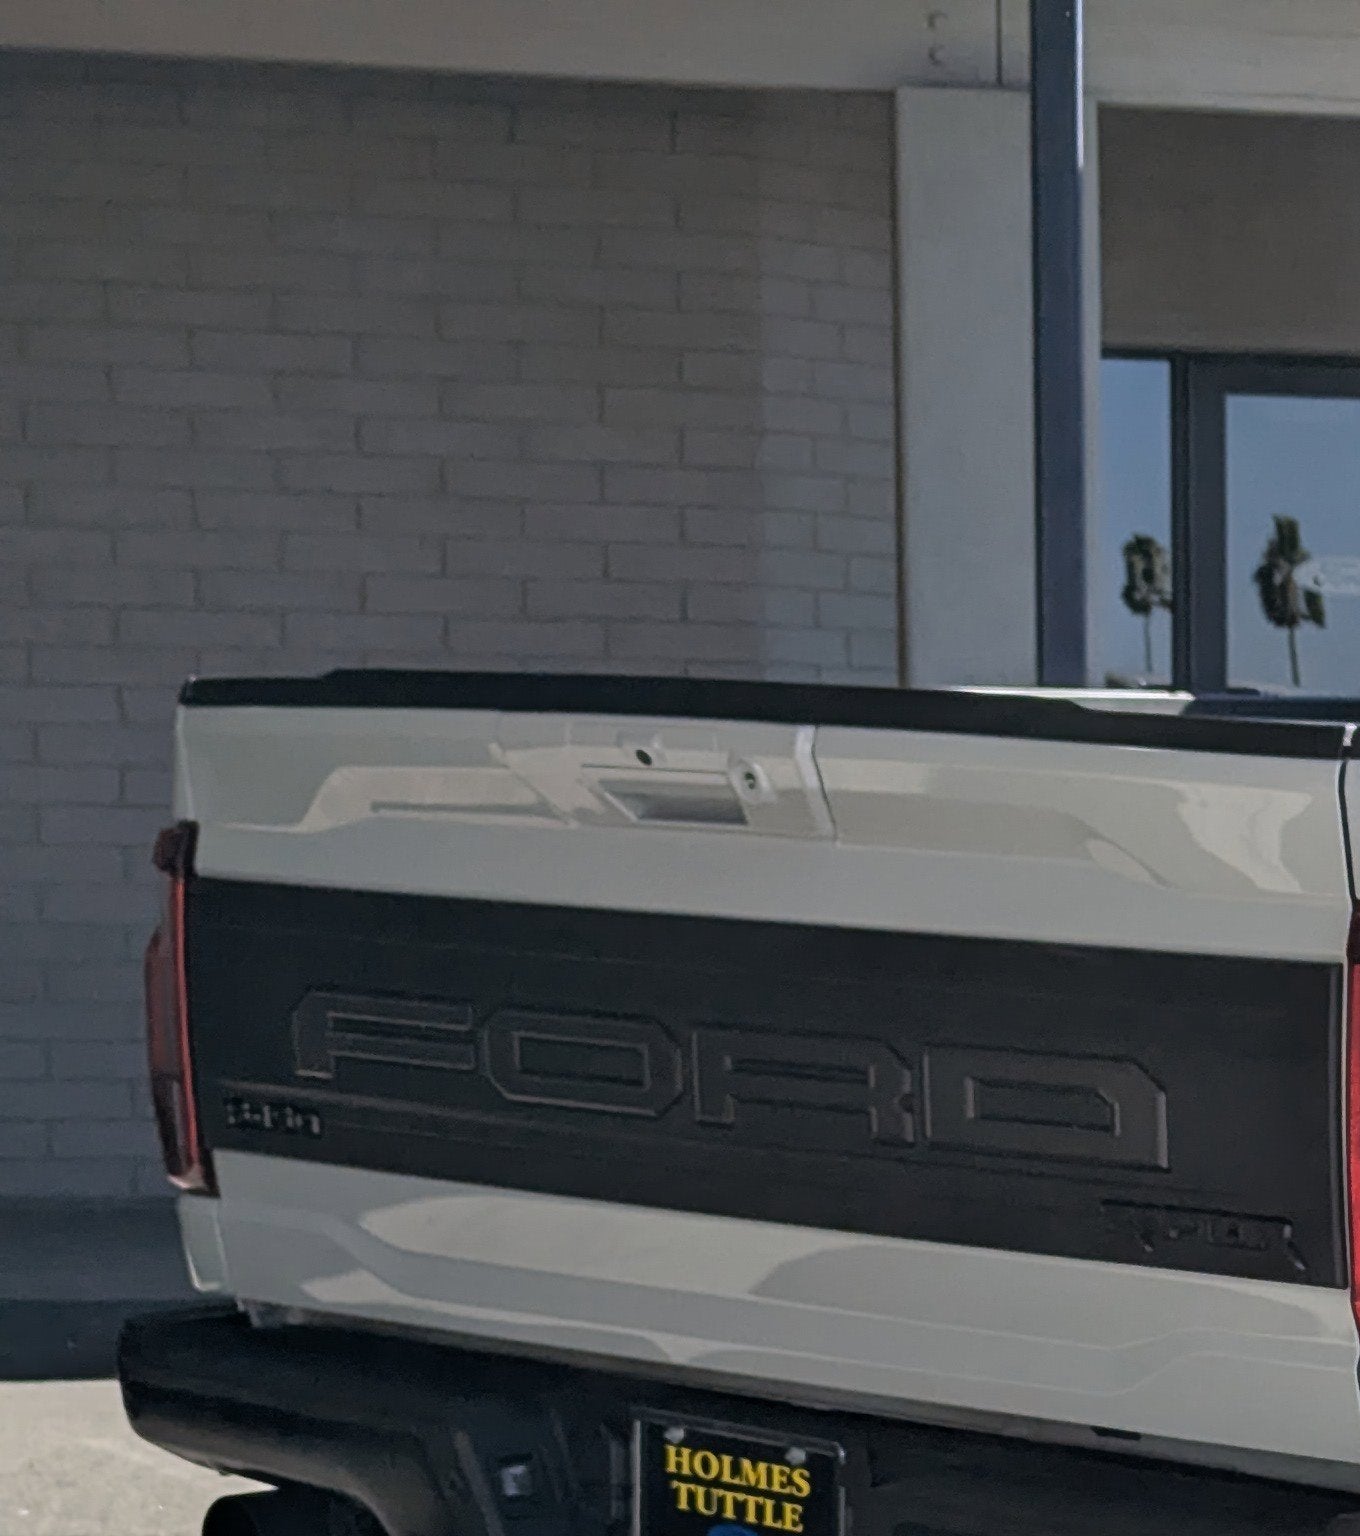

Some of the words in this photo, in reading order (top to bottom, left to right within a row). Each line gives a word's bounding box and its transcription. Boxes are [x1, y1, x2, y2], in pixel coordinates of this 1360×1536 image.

[291, 985, 1171, 1173] FORD
[664, 1443, 811, 1498] HOLMES
[670, 1480, 803, 1533] TUTTLE
